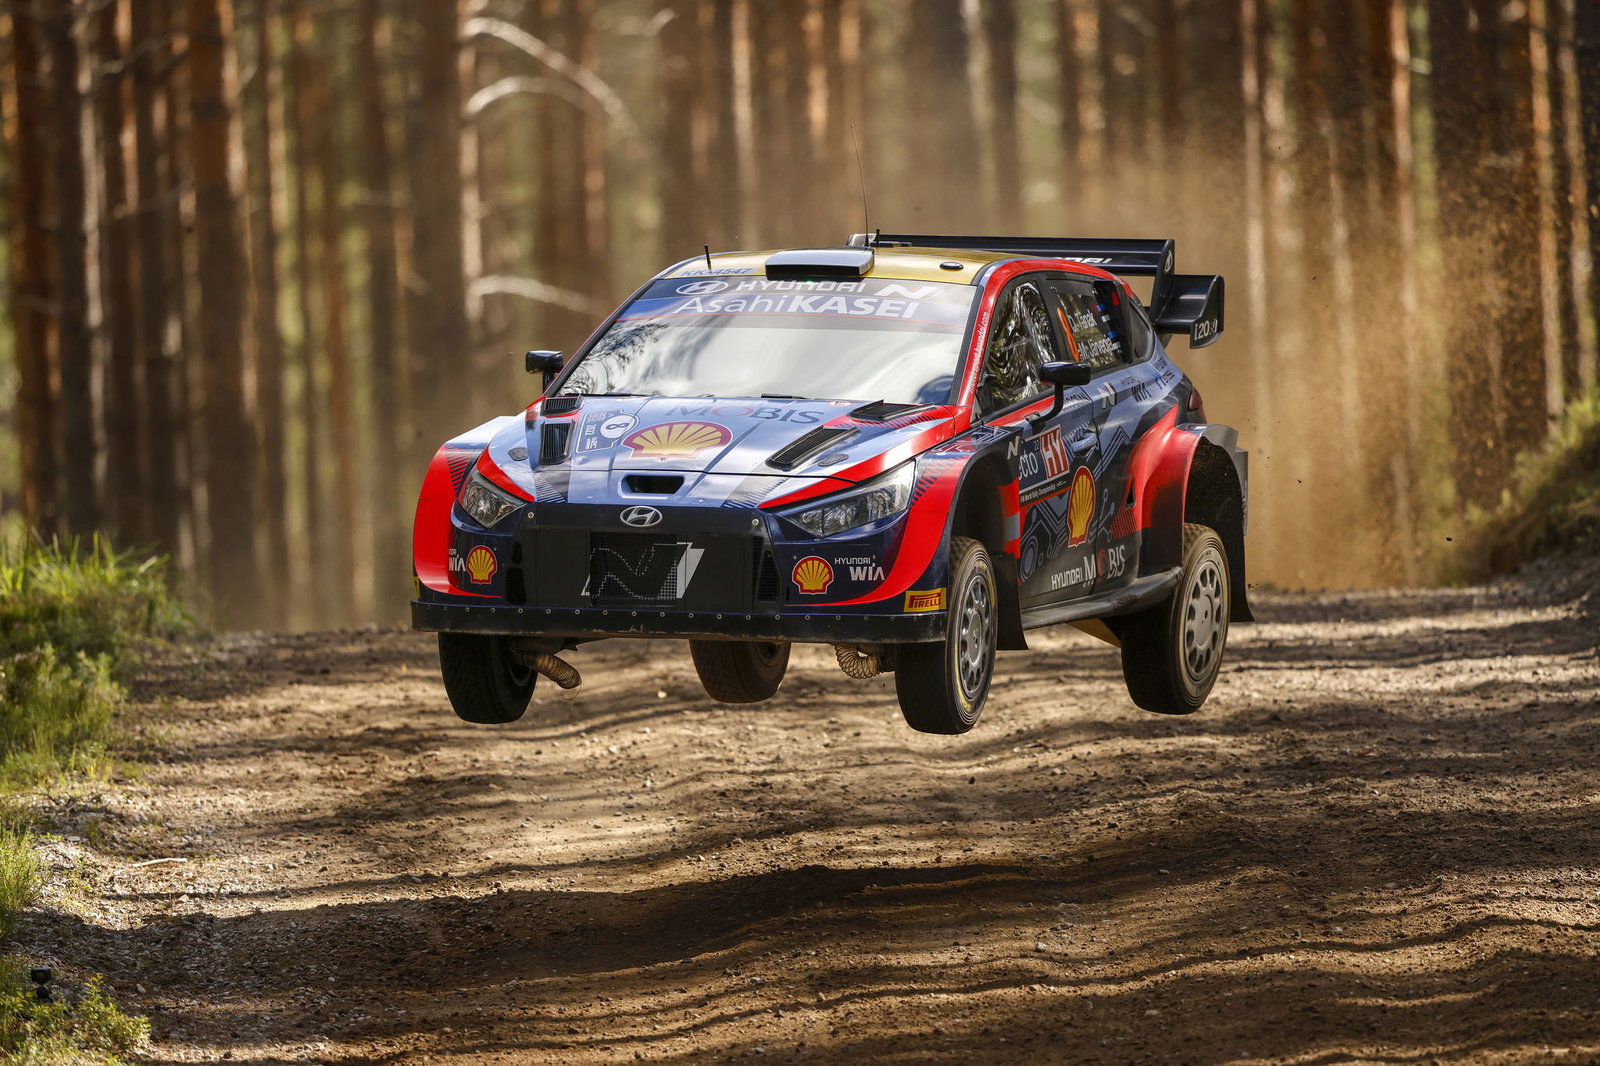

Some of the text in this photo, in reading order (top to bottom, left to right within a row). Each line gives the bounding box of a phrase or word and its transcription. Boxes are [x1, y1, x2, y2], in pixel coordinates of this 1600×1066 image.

[736, 280, 867, 293] HYUNDAI
[1194, 320, 1210, 341] i20
[664, 405, 825, 424] MOBIS
[605, 422, 630, 430] 8
[1007, 435, 1020, 460] N
[1041, 429, 1065, 478] HY
[834, 557, 871, 565] HYUNDAI
[1051, 545, 1126, 590] HYUNDAI MOBIS
[849, 563, 885, 581] WIA
[907, 592, 942, 609] PIRELLI
